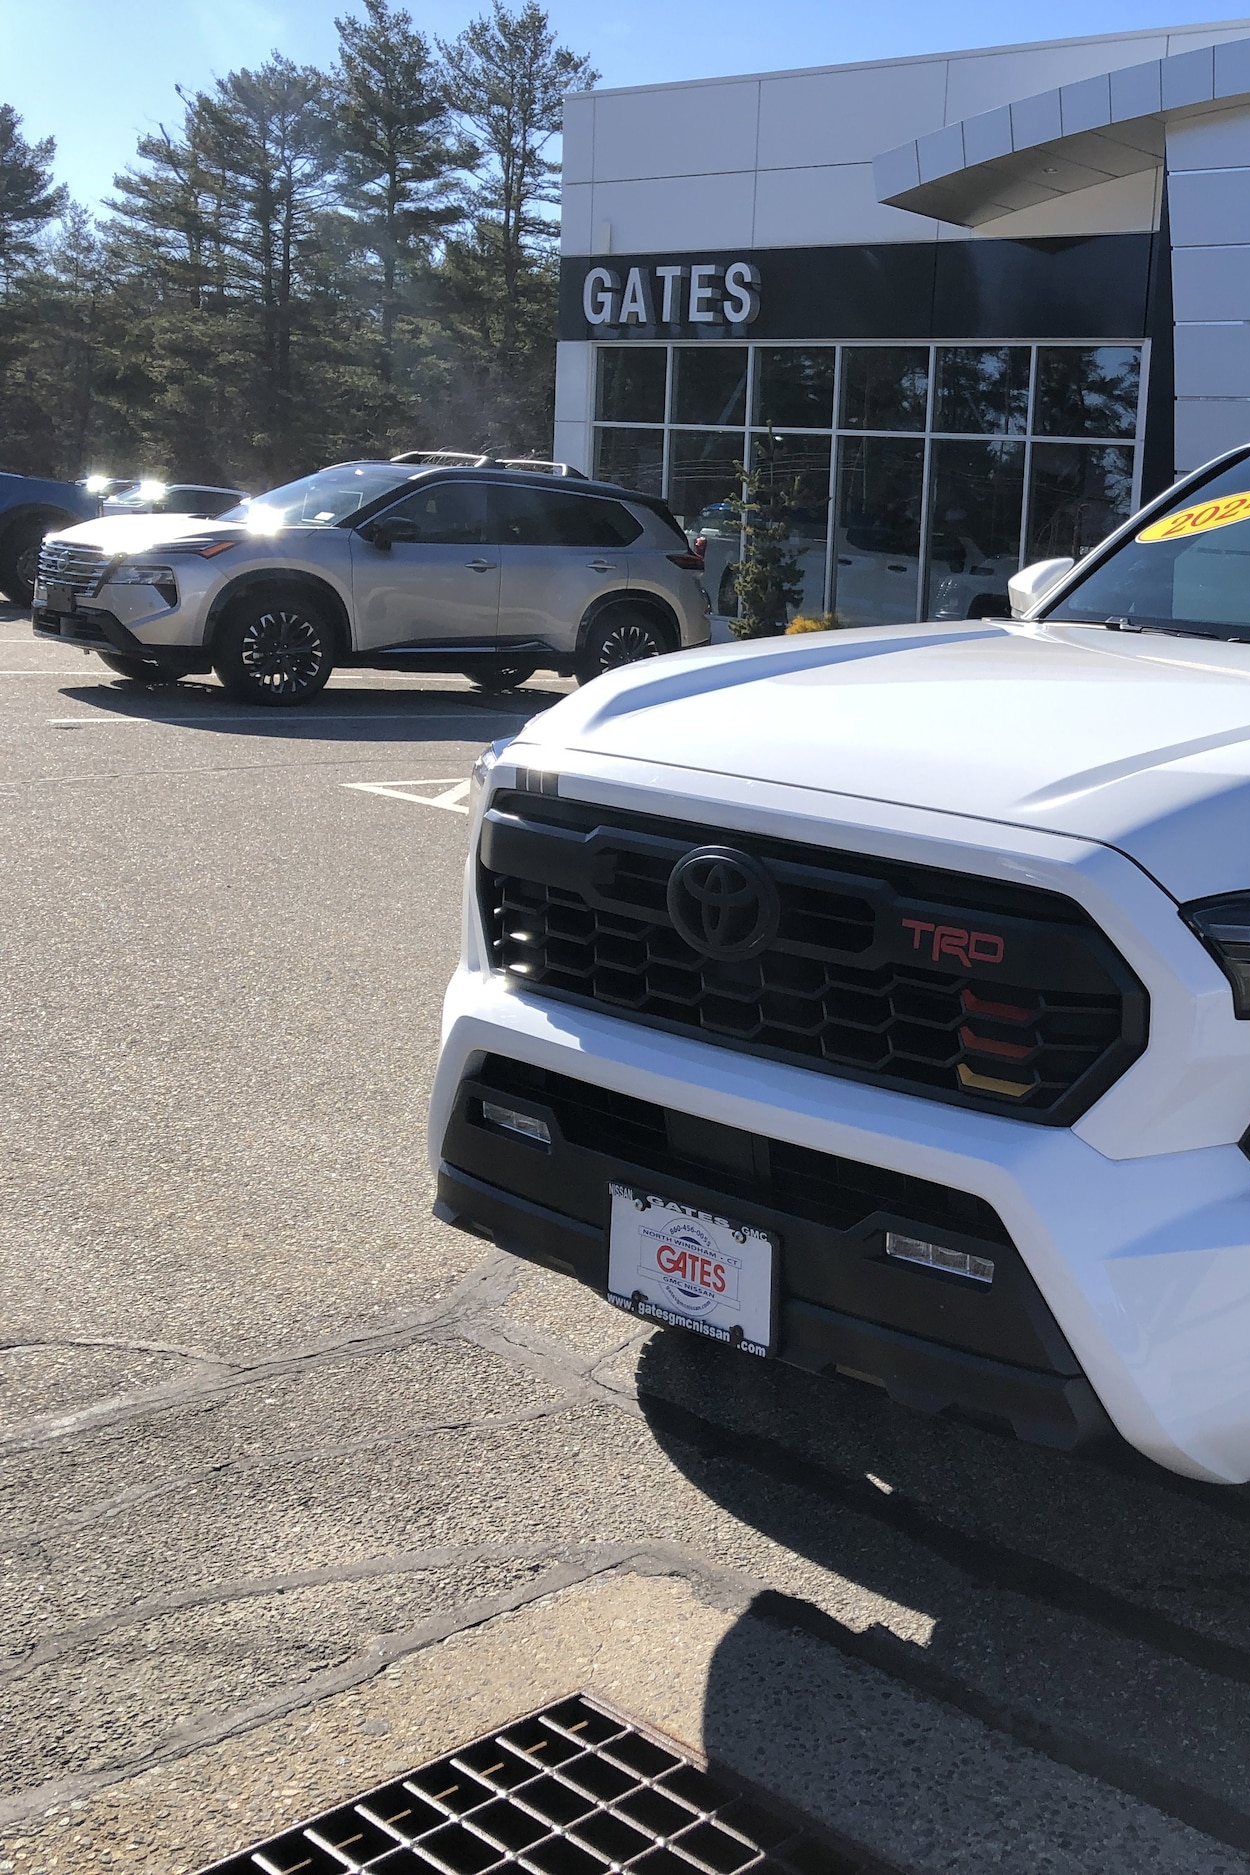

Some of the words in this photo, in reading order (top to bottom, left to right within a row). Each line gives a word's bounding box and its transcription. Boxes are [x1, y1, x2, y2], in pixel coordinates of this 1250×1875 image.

[583, 262, 754, 325] GATES
[902, 918, 1005, 968] TRD
[608, 1183, 633, 1202] NISSAN
[646, 1195, 731, 1228] GATES
[643, 1228, 673, 1243] NORTH
[674, 1238, 718, 1259] WINDHAM
[727, 1257, 738, 1266] CT
[741, 1226, 769, 1242] GMC
[656, 1244, 726, 1293] GATES
[662, 1276, 684, 1288] GMC
[684, 1283, 716, 1299] NISSAN
[638, 1301, 731, 1343] gatesgmcnissan
